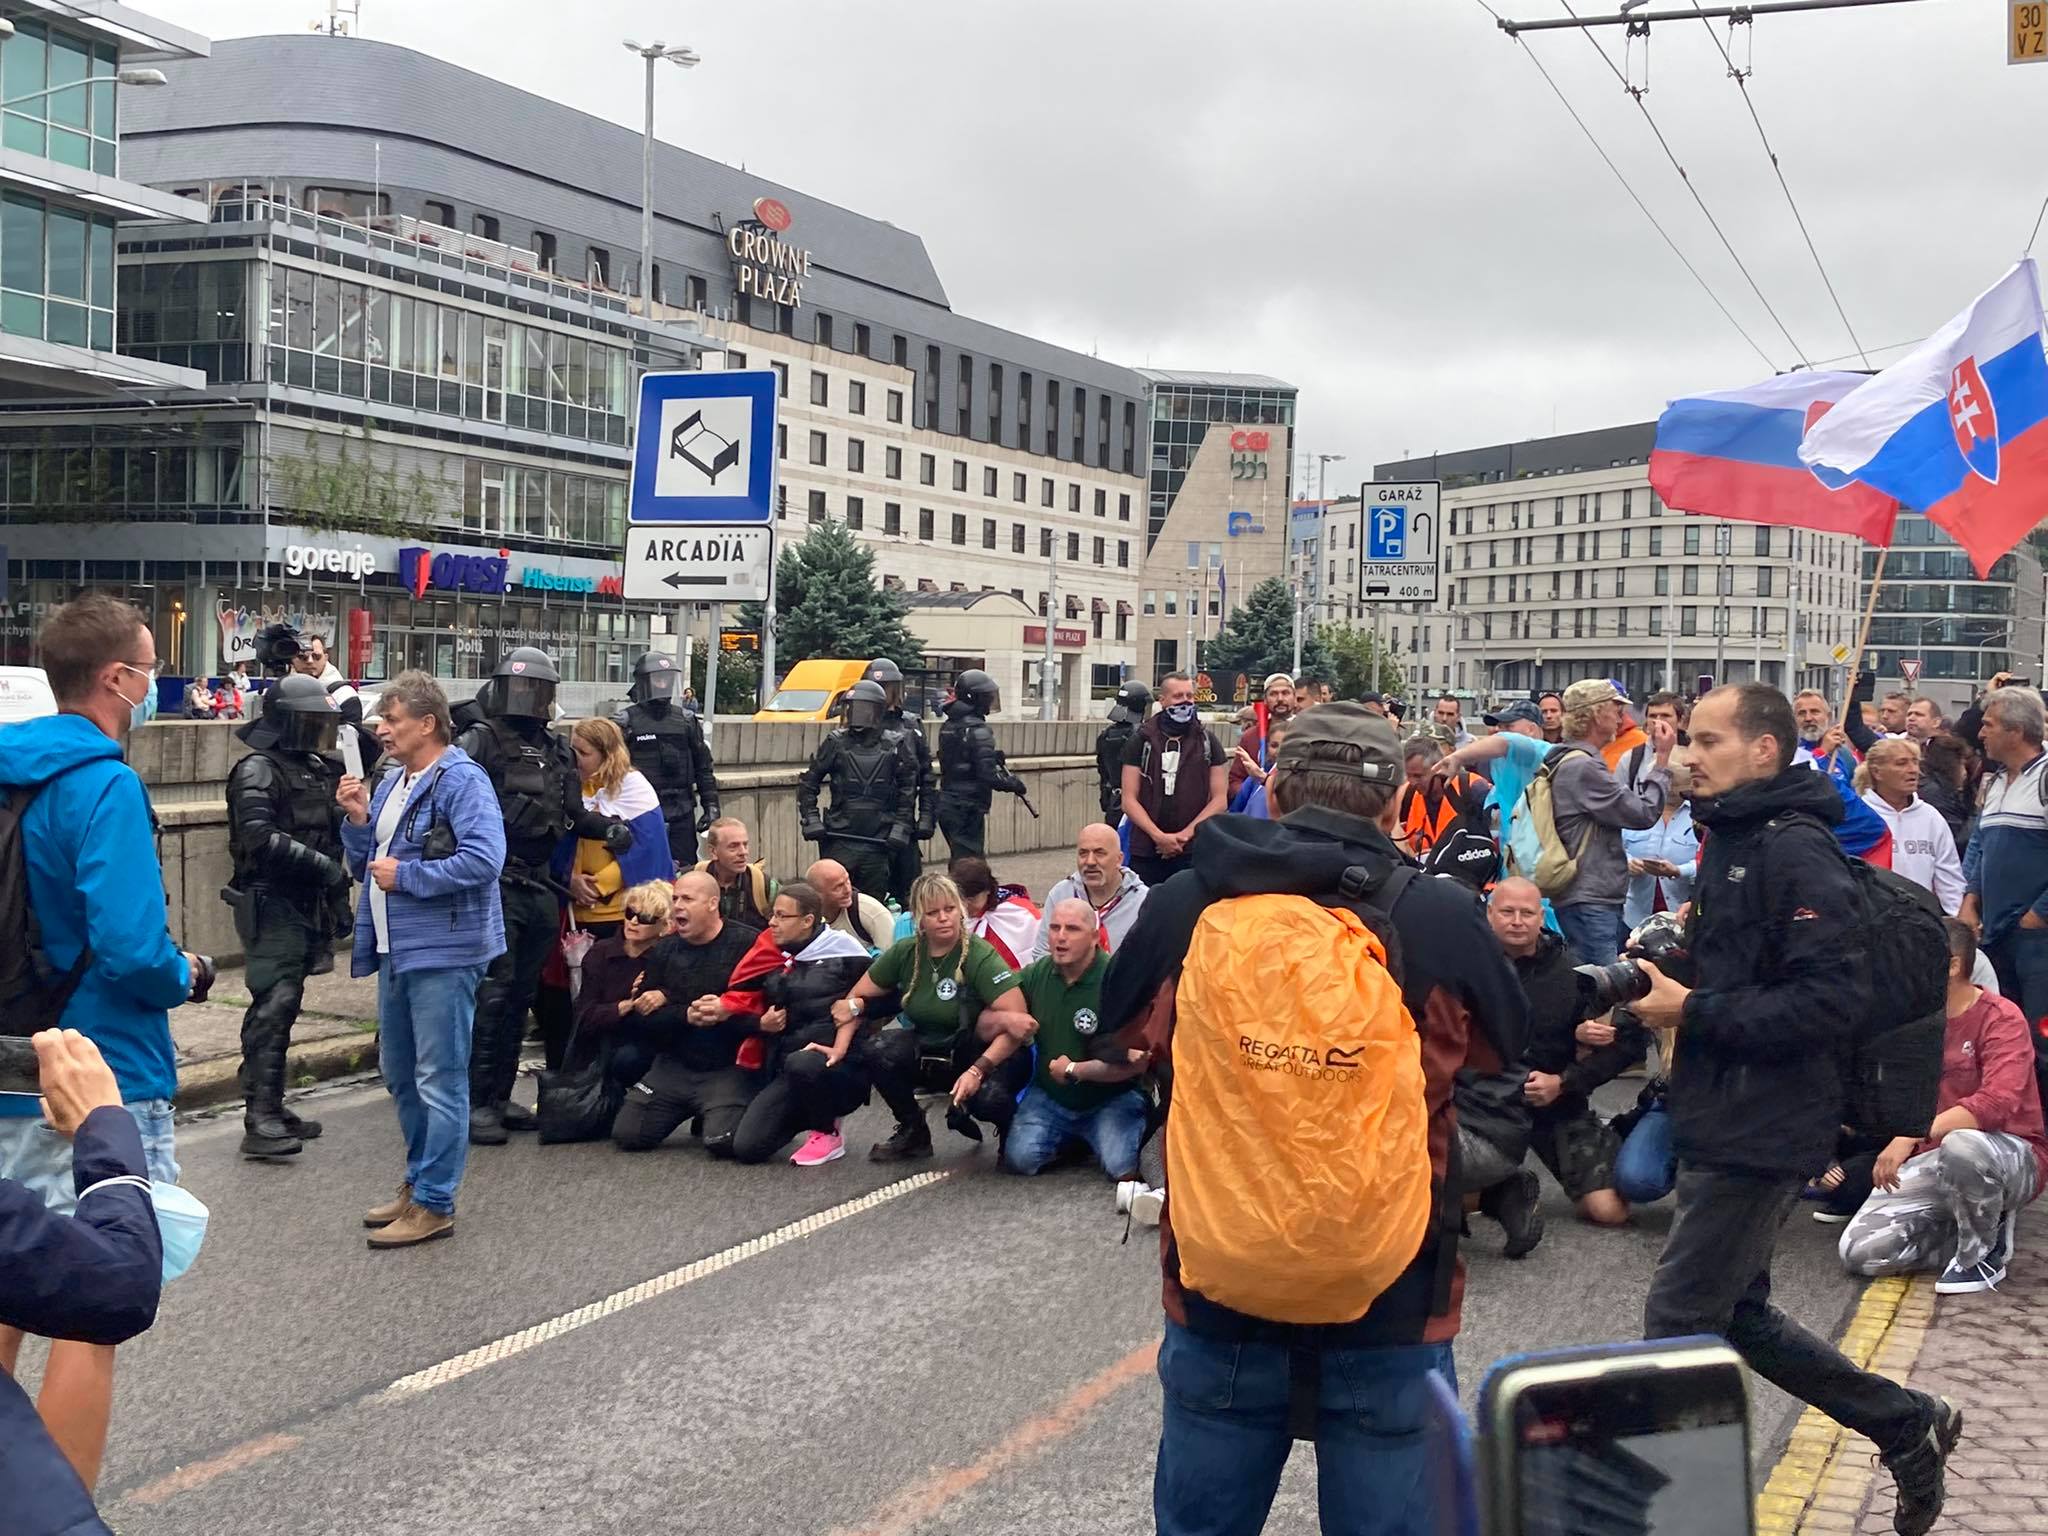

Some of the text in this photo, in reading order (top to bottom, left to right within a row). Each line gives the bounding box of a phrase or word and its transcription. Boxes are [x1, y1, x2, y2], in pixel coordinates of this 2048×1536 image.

[2020, 5, 2041, 29] 30
[731, 228, 812, 278] CROWNE
[739, 265, 802, 308] PLAZA
[1379, 487, 1422, 501] GARÁŽ
[286, 544, 376, 580] gorenje
[645, 540, 744, 561] ARCADIA
[432, 548, 510, 596] oresi
[523, 567, 594, 593] Hisense
[1363, 565, 1435, 576] TATRACENTRUM
[1399, 586, 1419, 597] 400
[1457, 848, 1492, 862] adidas
[1239, 1036, 1320, 1066] REGATTA
